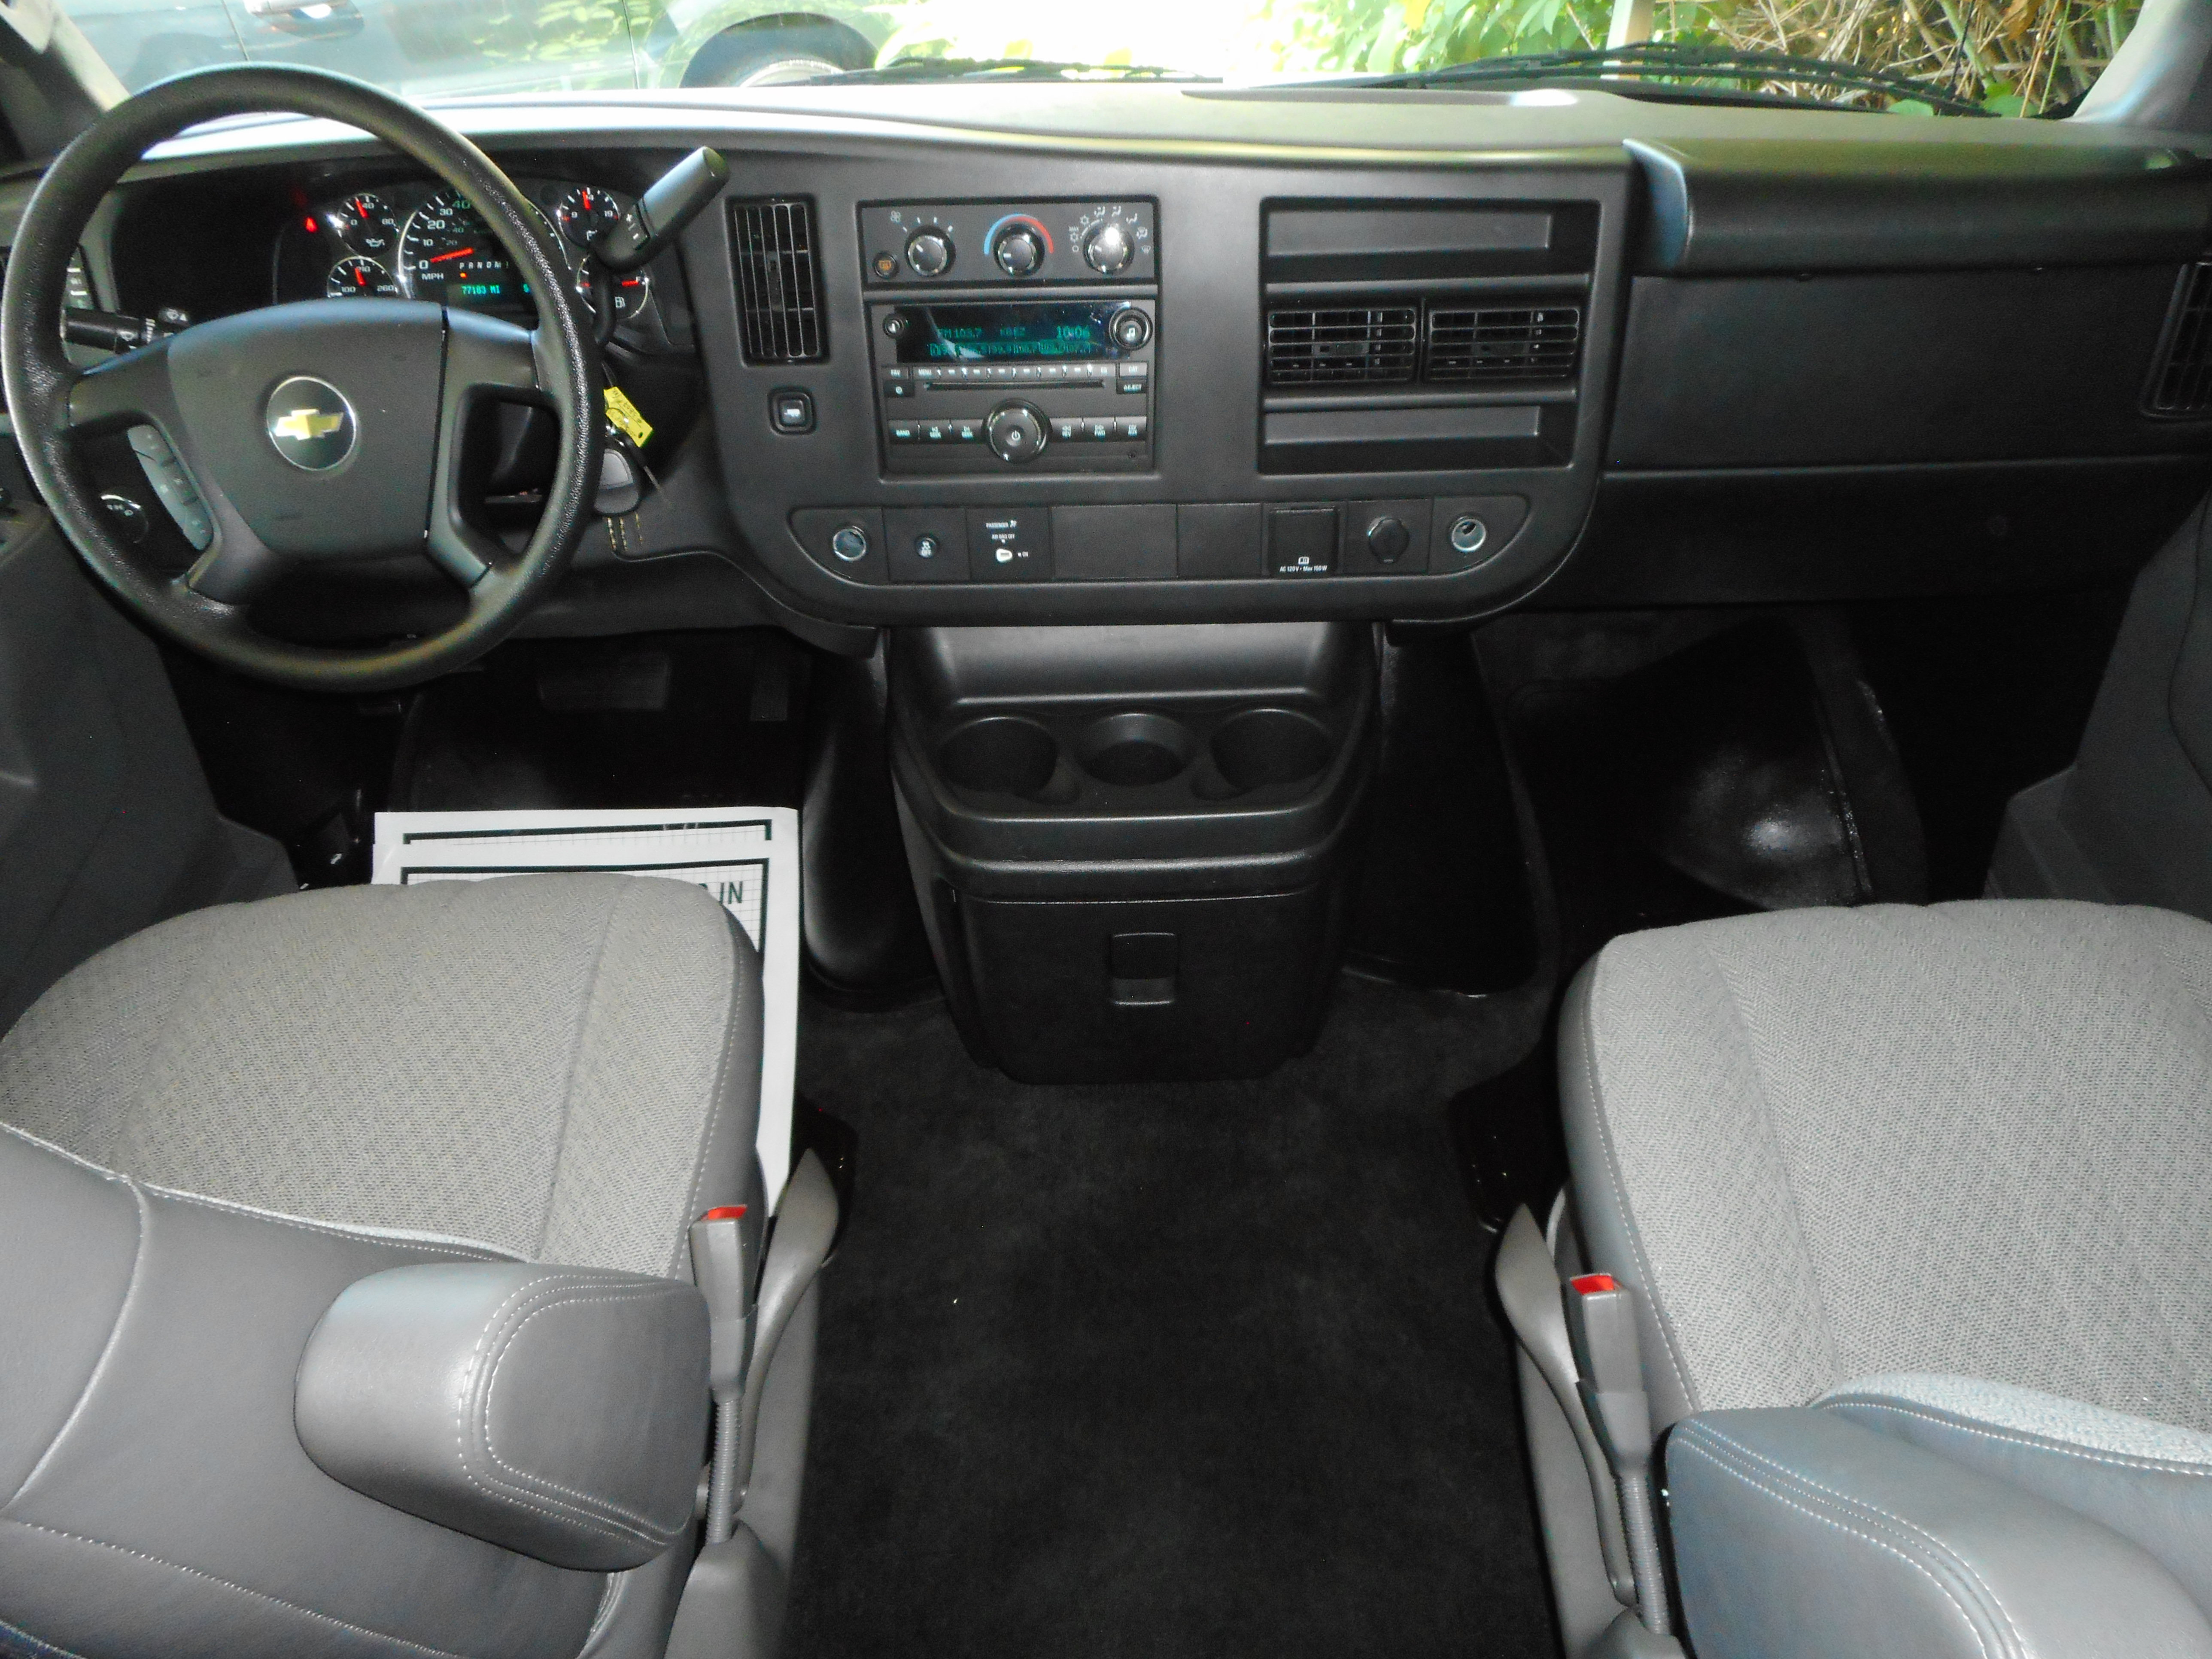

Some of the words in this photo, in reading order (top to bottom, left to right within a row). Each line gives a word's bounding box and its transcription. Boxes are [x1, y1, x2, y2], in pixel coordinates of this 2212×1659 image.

[452, 200, 471, 209] 40
[427, 219, 446, 230] 20
[422, 238, 434, 247] 10
[419, 259, 429, 270] 0
